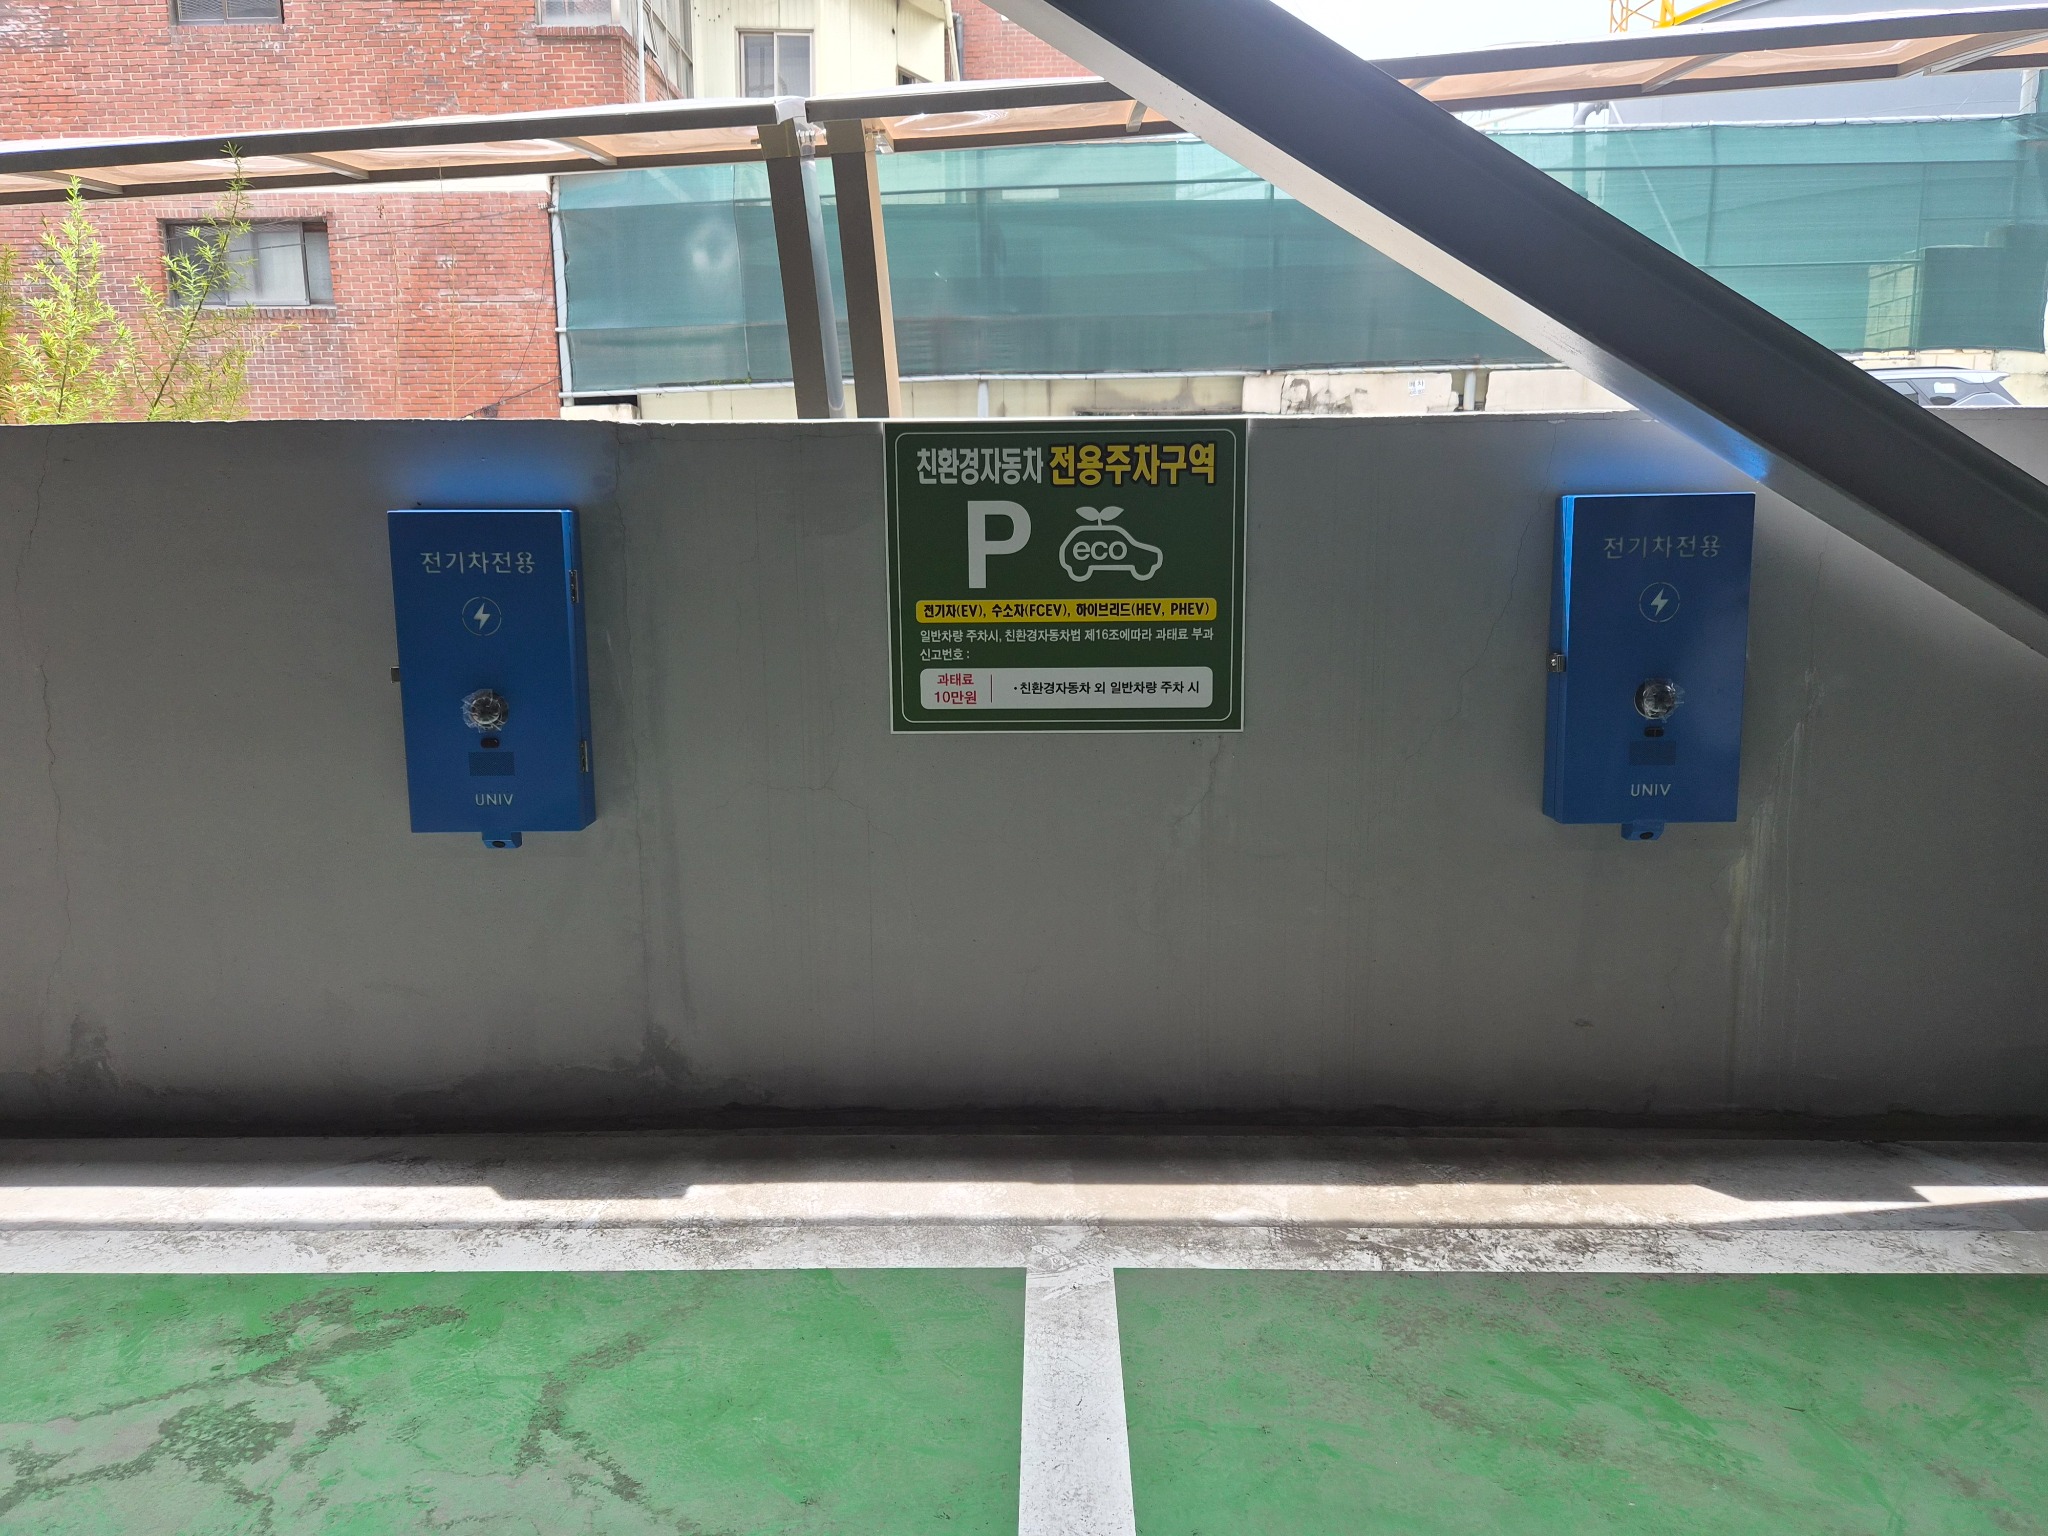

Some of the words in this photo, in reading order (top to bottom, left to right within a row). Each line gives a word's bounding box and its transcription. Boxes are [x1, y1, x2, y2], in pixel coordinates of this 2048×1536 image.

[917, 447, 1043, 484] 친환경자동차
[1050, 443, 1216, 485] 전용주차구역
[967, 500, 1032, 589] P
[1073, 541, 1128, 561] eco
[1603, 534, 1722, 560] 전기차전용
[420, 551, 536, 575] 전기차전용
[1076, 602, 1165, 617] 하이브리드(HEV,
[1170, 602, 1210, 616] PHEV)
[920, 629, 963, 643] 일반차량
[966, 629, 1002, 643] 주차시,
[1004, 628, 1081, 642] 친환경자동차법
[1084, 627, 1152, 641] 제16조에따라
[1155, 627, 1189, 641] 과태료
[1191, 626, 1214, 640] 부과
[919, 648, 964, 661] 신고번호
[936, 673, 974, 686] 과태료
[1094, 681, 1106, 694] 외
[1110, 681, 1157, 694] 일반차량
[1160, 680, 1184, 693] 주차
[1187, 680, 1200, 693] 시
[934, 691, 977, 704] 10만원
[1629, 783, 1672, 797] UNIV
[475, 793, 514, 806] UNIV
